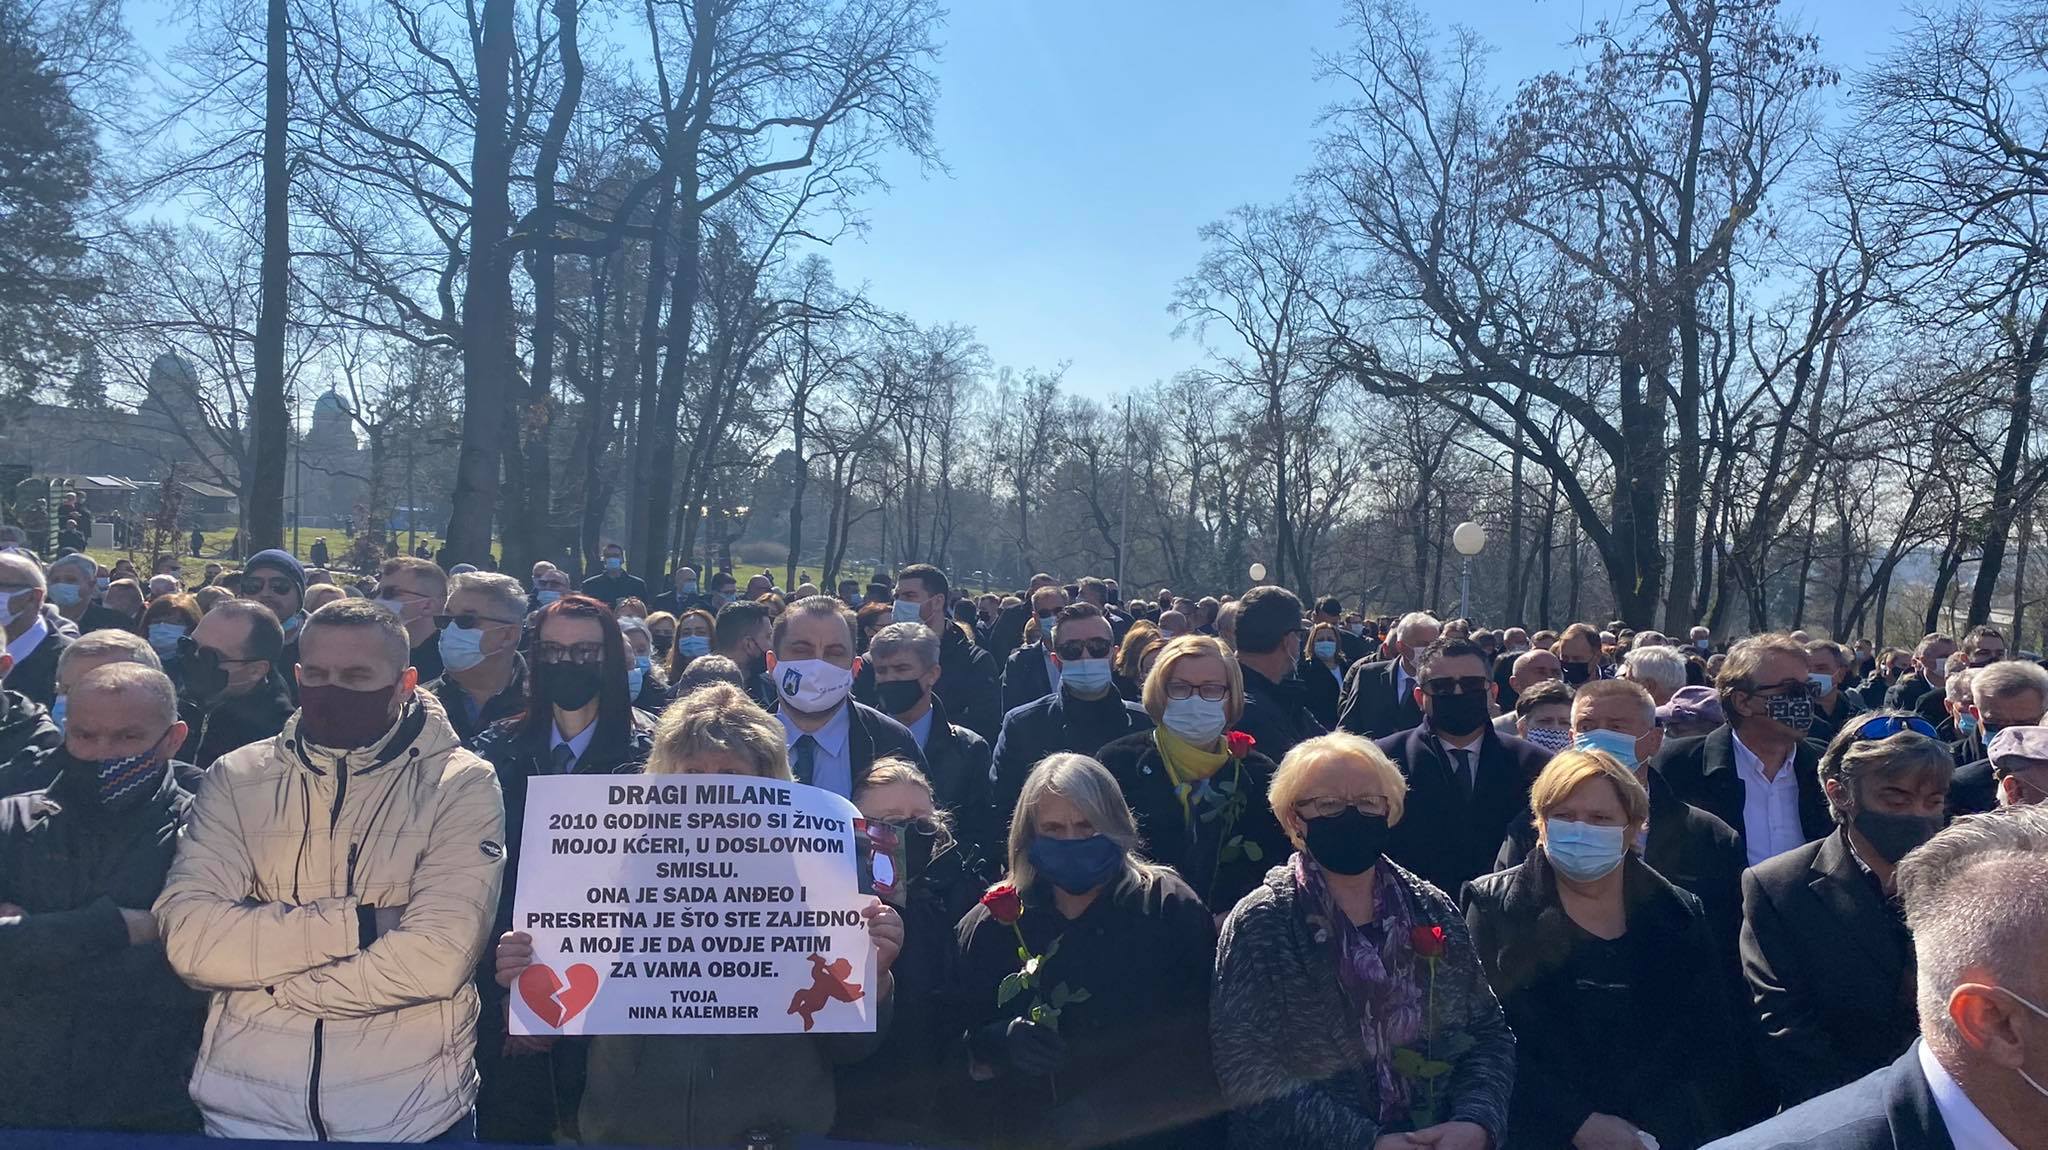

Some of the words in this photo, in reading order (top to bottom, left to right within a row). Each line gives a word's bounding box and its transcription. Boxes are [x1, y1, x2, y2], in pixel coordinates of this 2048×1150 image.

[608, 785, 688, 805] DRAGI
[695, 784, 792, 807] MILANE
[548, 813, 598, 830] 2010
[603, 812, 683, 830] GODINE
[686, 812, 762, 830] SPASIO
[766, 812, 788, 829] SI
[792, 809, 846, 834] ŽIVOT
[551, 837, 617, 855] MOJOJ
[622, 832, 690, 858] KĆERI,
[696, 837, 710, 854] U
[715, 836, 844, 854] DOSLOVNOM
[655, 861, 739, 879] SMISLU.
[586, 887, 631, 905] ONA
[634, 886, 659, 904] JE
[663, 886, 719, 904] SADA
[722, 886, 795, 903] ANĐEO
[800, 886, 807, 903] I
[526, 911, 648, 929] PRESRETNA
[652, 911, 676, 929] JE
[680, 906, 720, 929] ŠTO
[723, 911, 762, 928] STE
[765, 909, 866, 930] ZAJEDNO,
[559, 936, 575, 954] A
[579, 936, 635, 954] MOJE
[638, 936, 663, 954] JE
[667, 936, 696, 953] DA
[701, 935, 766, 953] OVDJE
[770, 935, 831, 954] PATIM
[609, 961, 638, 979] ZA
[642, 960, 703, 979] VAMA
[707, 960, 779, 978] OBOJE.
[669, 989, 719, 1004] TVOJA
[628, 1006, 668, 1020] NINA
[671, 1005, 759, 1019] KALEMBER
